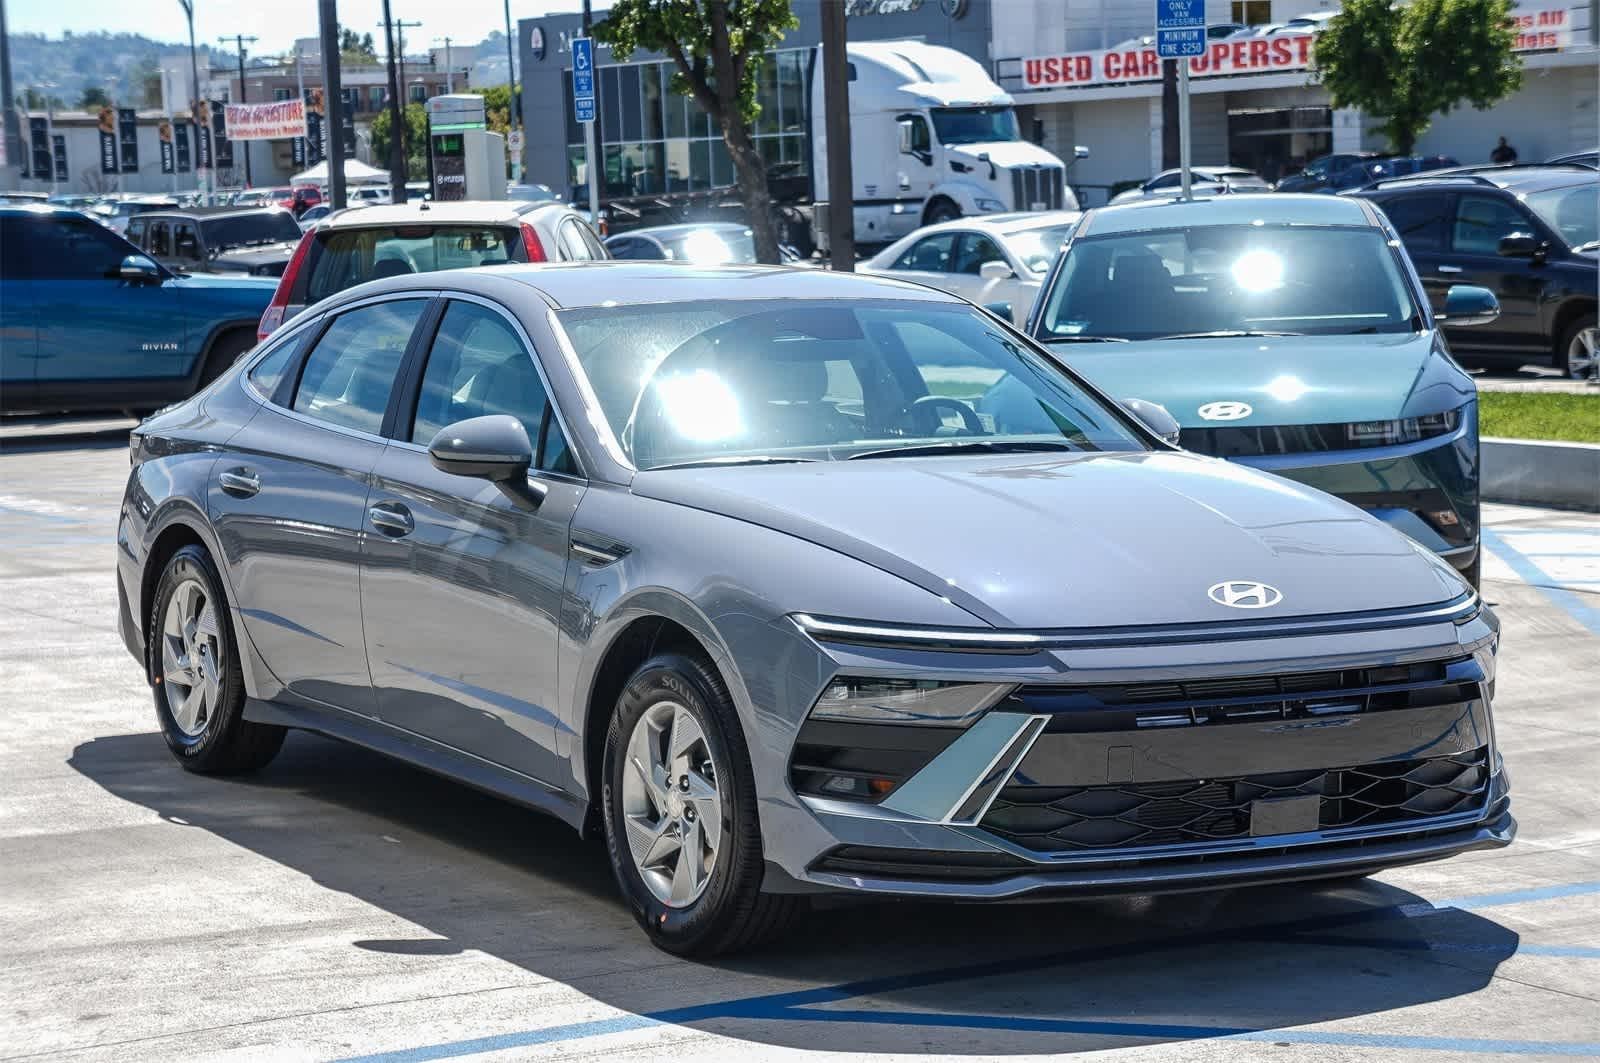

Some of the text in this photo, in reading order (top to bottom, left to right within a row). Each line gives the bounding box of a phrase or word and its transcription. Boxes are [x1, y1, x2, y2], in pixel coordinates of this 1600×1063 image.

[1169, 1, 1192, 10] ONLY
[1173, 10, 1190, 18] VAN
[1160, 17, 1204, 26] ACCESSIBLE
[1164, 30, 1199, 41] MINIMUM
[1161, 42, 1202, 55] FINE $250
[1026, 35, 1313, 85] USED CAR UPERST
[142, 343, 178, 351] RIVIAN
